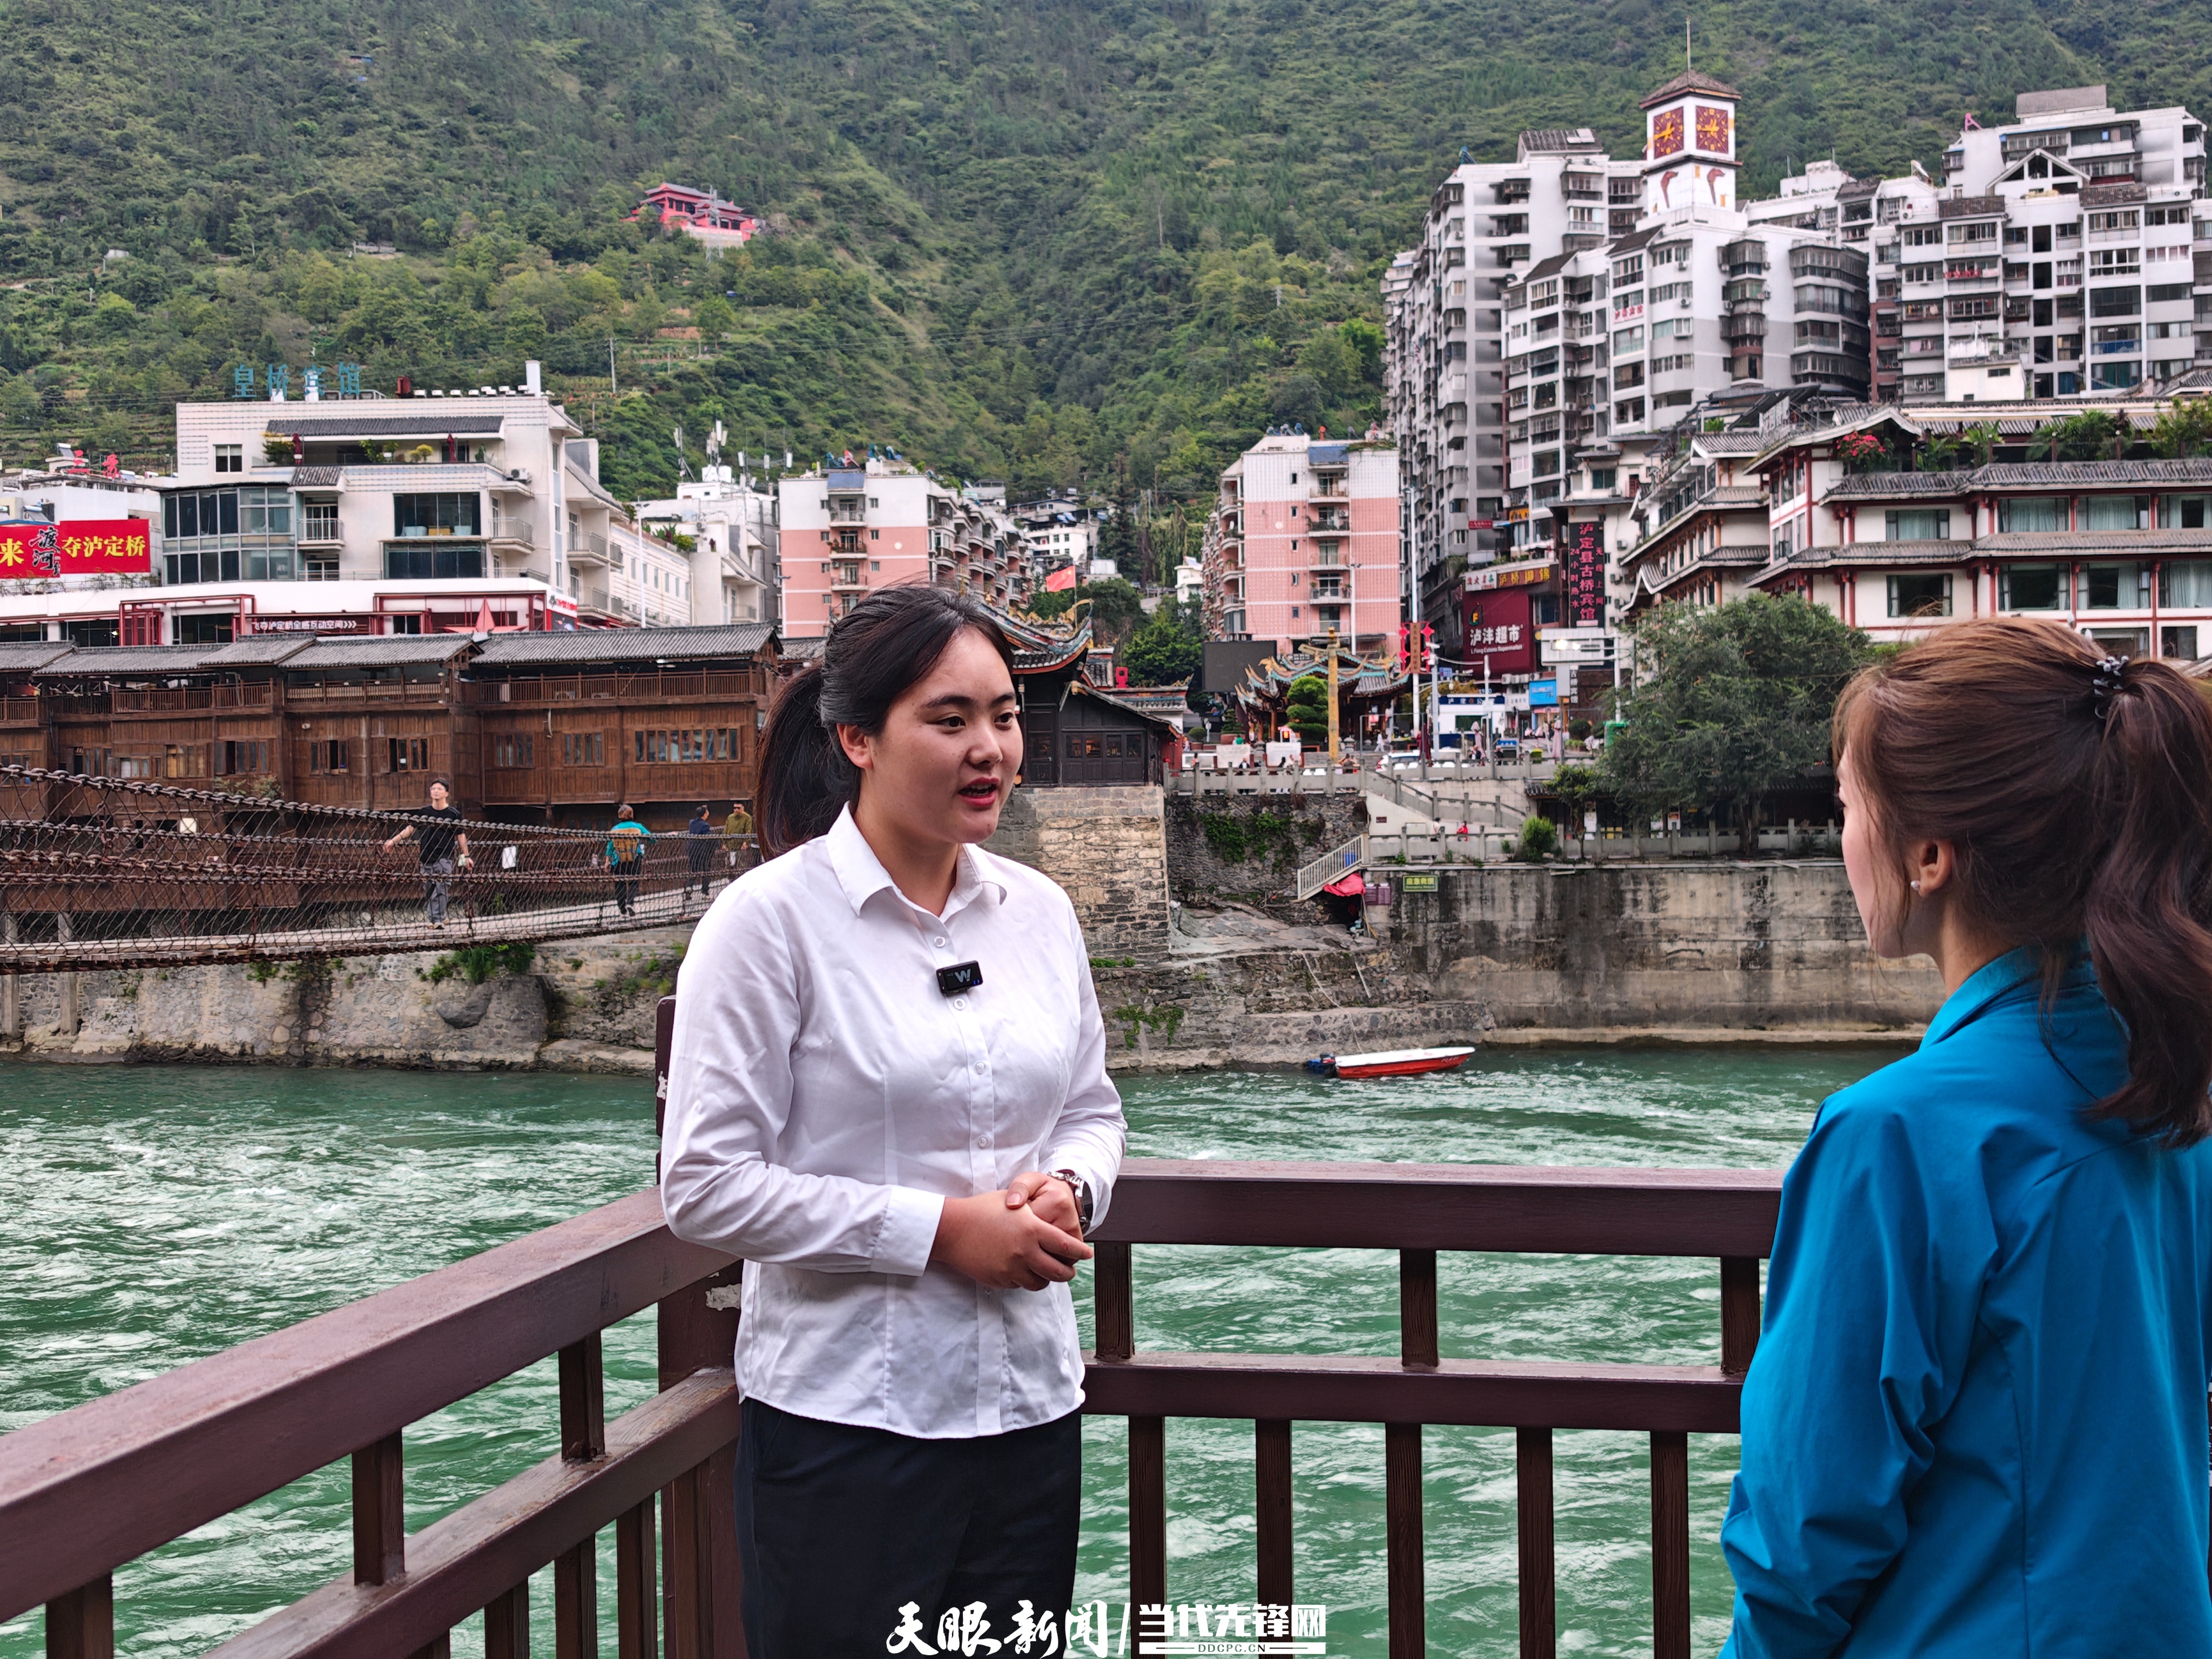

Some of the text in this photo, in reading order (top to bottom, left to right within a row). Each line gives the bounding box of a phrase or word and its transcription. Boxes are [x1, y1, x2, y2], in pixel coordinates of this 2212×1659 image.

[0, 538, 24, 567] 来
[62, 535, 145, 558] 夺泸定桥
[1579, 523, 1595, 619] 泸定县古桥宾馆
